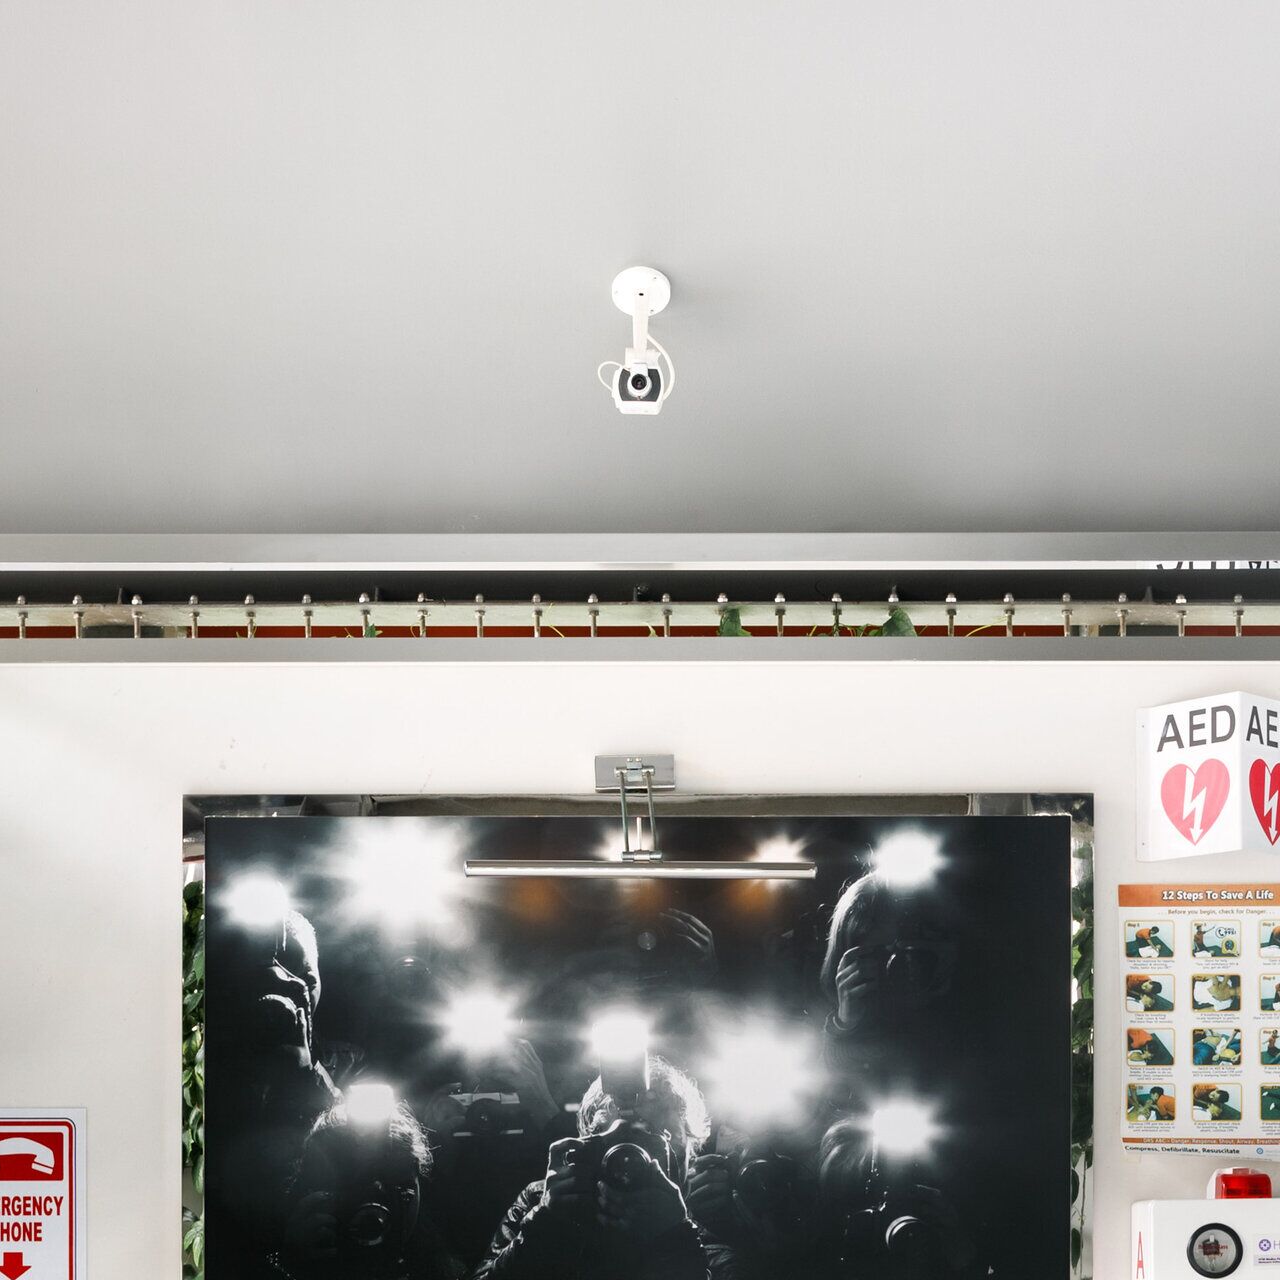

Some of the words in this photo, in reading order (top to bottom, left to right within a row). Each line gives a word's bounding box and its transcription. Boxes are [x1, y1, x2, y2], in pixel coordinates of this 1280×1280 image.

[1157, 705, 1235, 752] AED
[1162, 890, 1174, 900] 12
[1176, 890, 1203, 902] Steps
[1206, 890, 1218, 900] To
[1220, 890, 1244, 900] Save
[1245, 890, 1253, 900] A
[1256, 890, 1274, 900] Life
